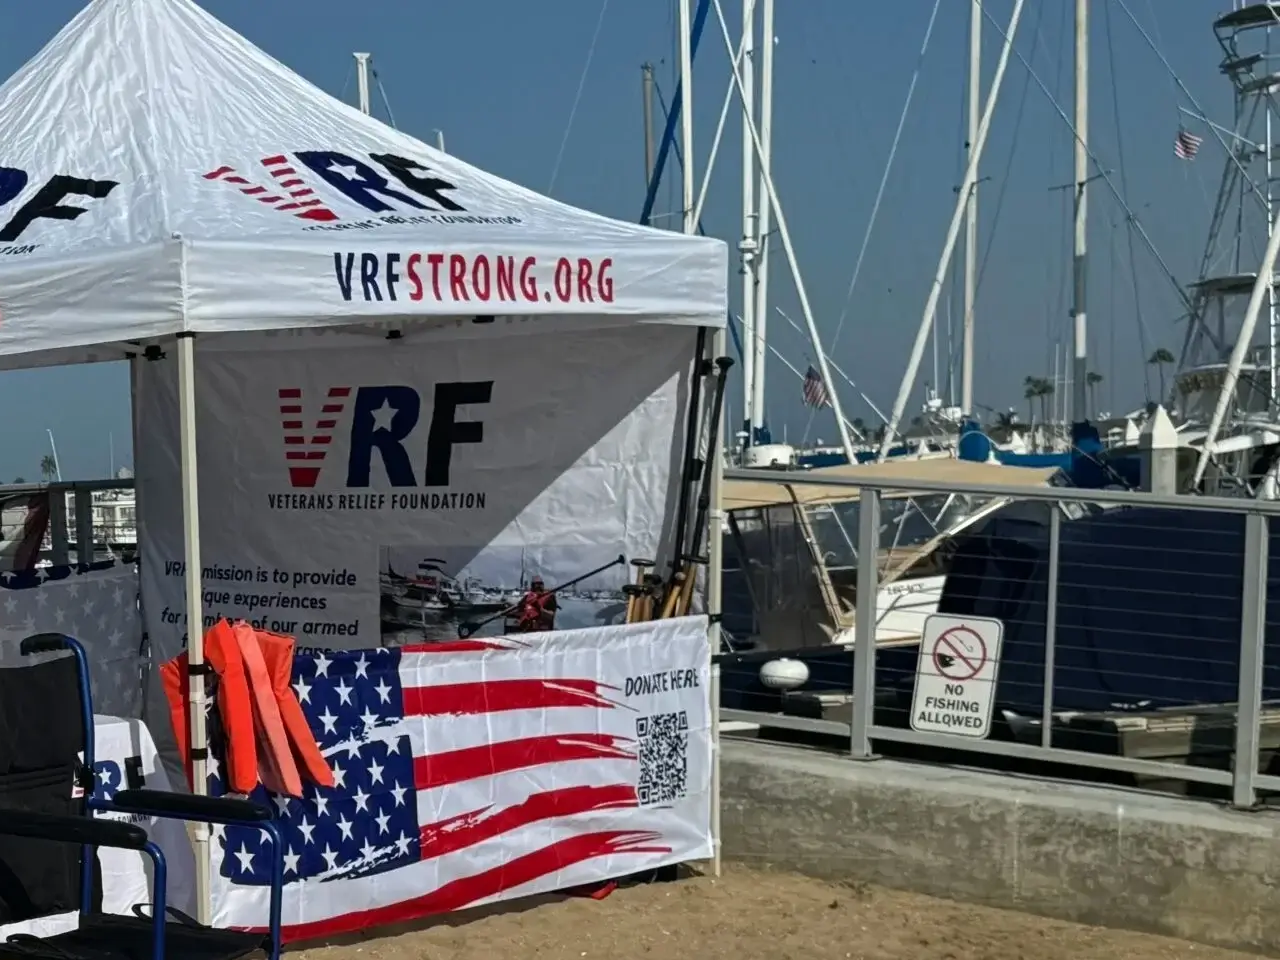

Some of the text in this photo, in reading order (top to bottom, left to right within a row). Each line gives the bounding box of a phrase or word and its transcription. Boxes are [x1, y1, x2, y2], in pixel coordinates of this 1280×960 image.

[202, 151, 468, 221] VRF
[333, 252, 614, 303] VRFSTRONG.ORG
[278, 380, 495, 488] VRF
[268, 491, 486, 510] VETERANS RELIEF FOUNDATION
[201, 563, 253, 582] mission
[256, 565, 269, 583] is
[271, 567, 289, 585] to
[292, 568, 357, 589] provide
[233, 591, 328, 612] experiences
[161, 606, 182, 625] for
[270, 620, 298, 634] our
[301, 618, 360, 637] armed
[625, 668, 700, 697] DONATE HERE
[944, 683, 965, 696] NO
[924, 697, 980, 714] FISHING
[917, 711, 983, 730] ALLOWED
